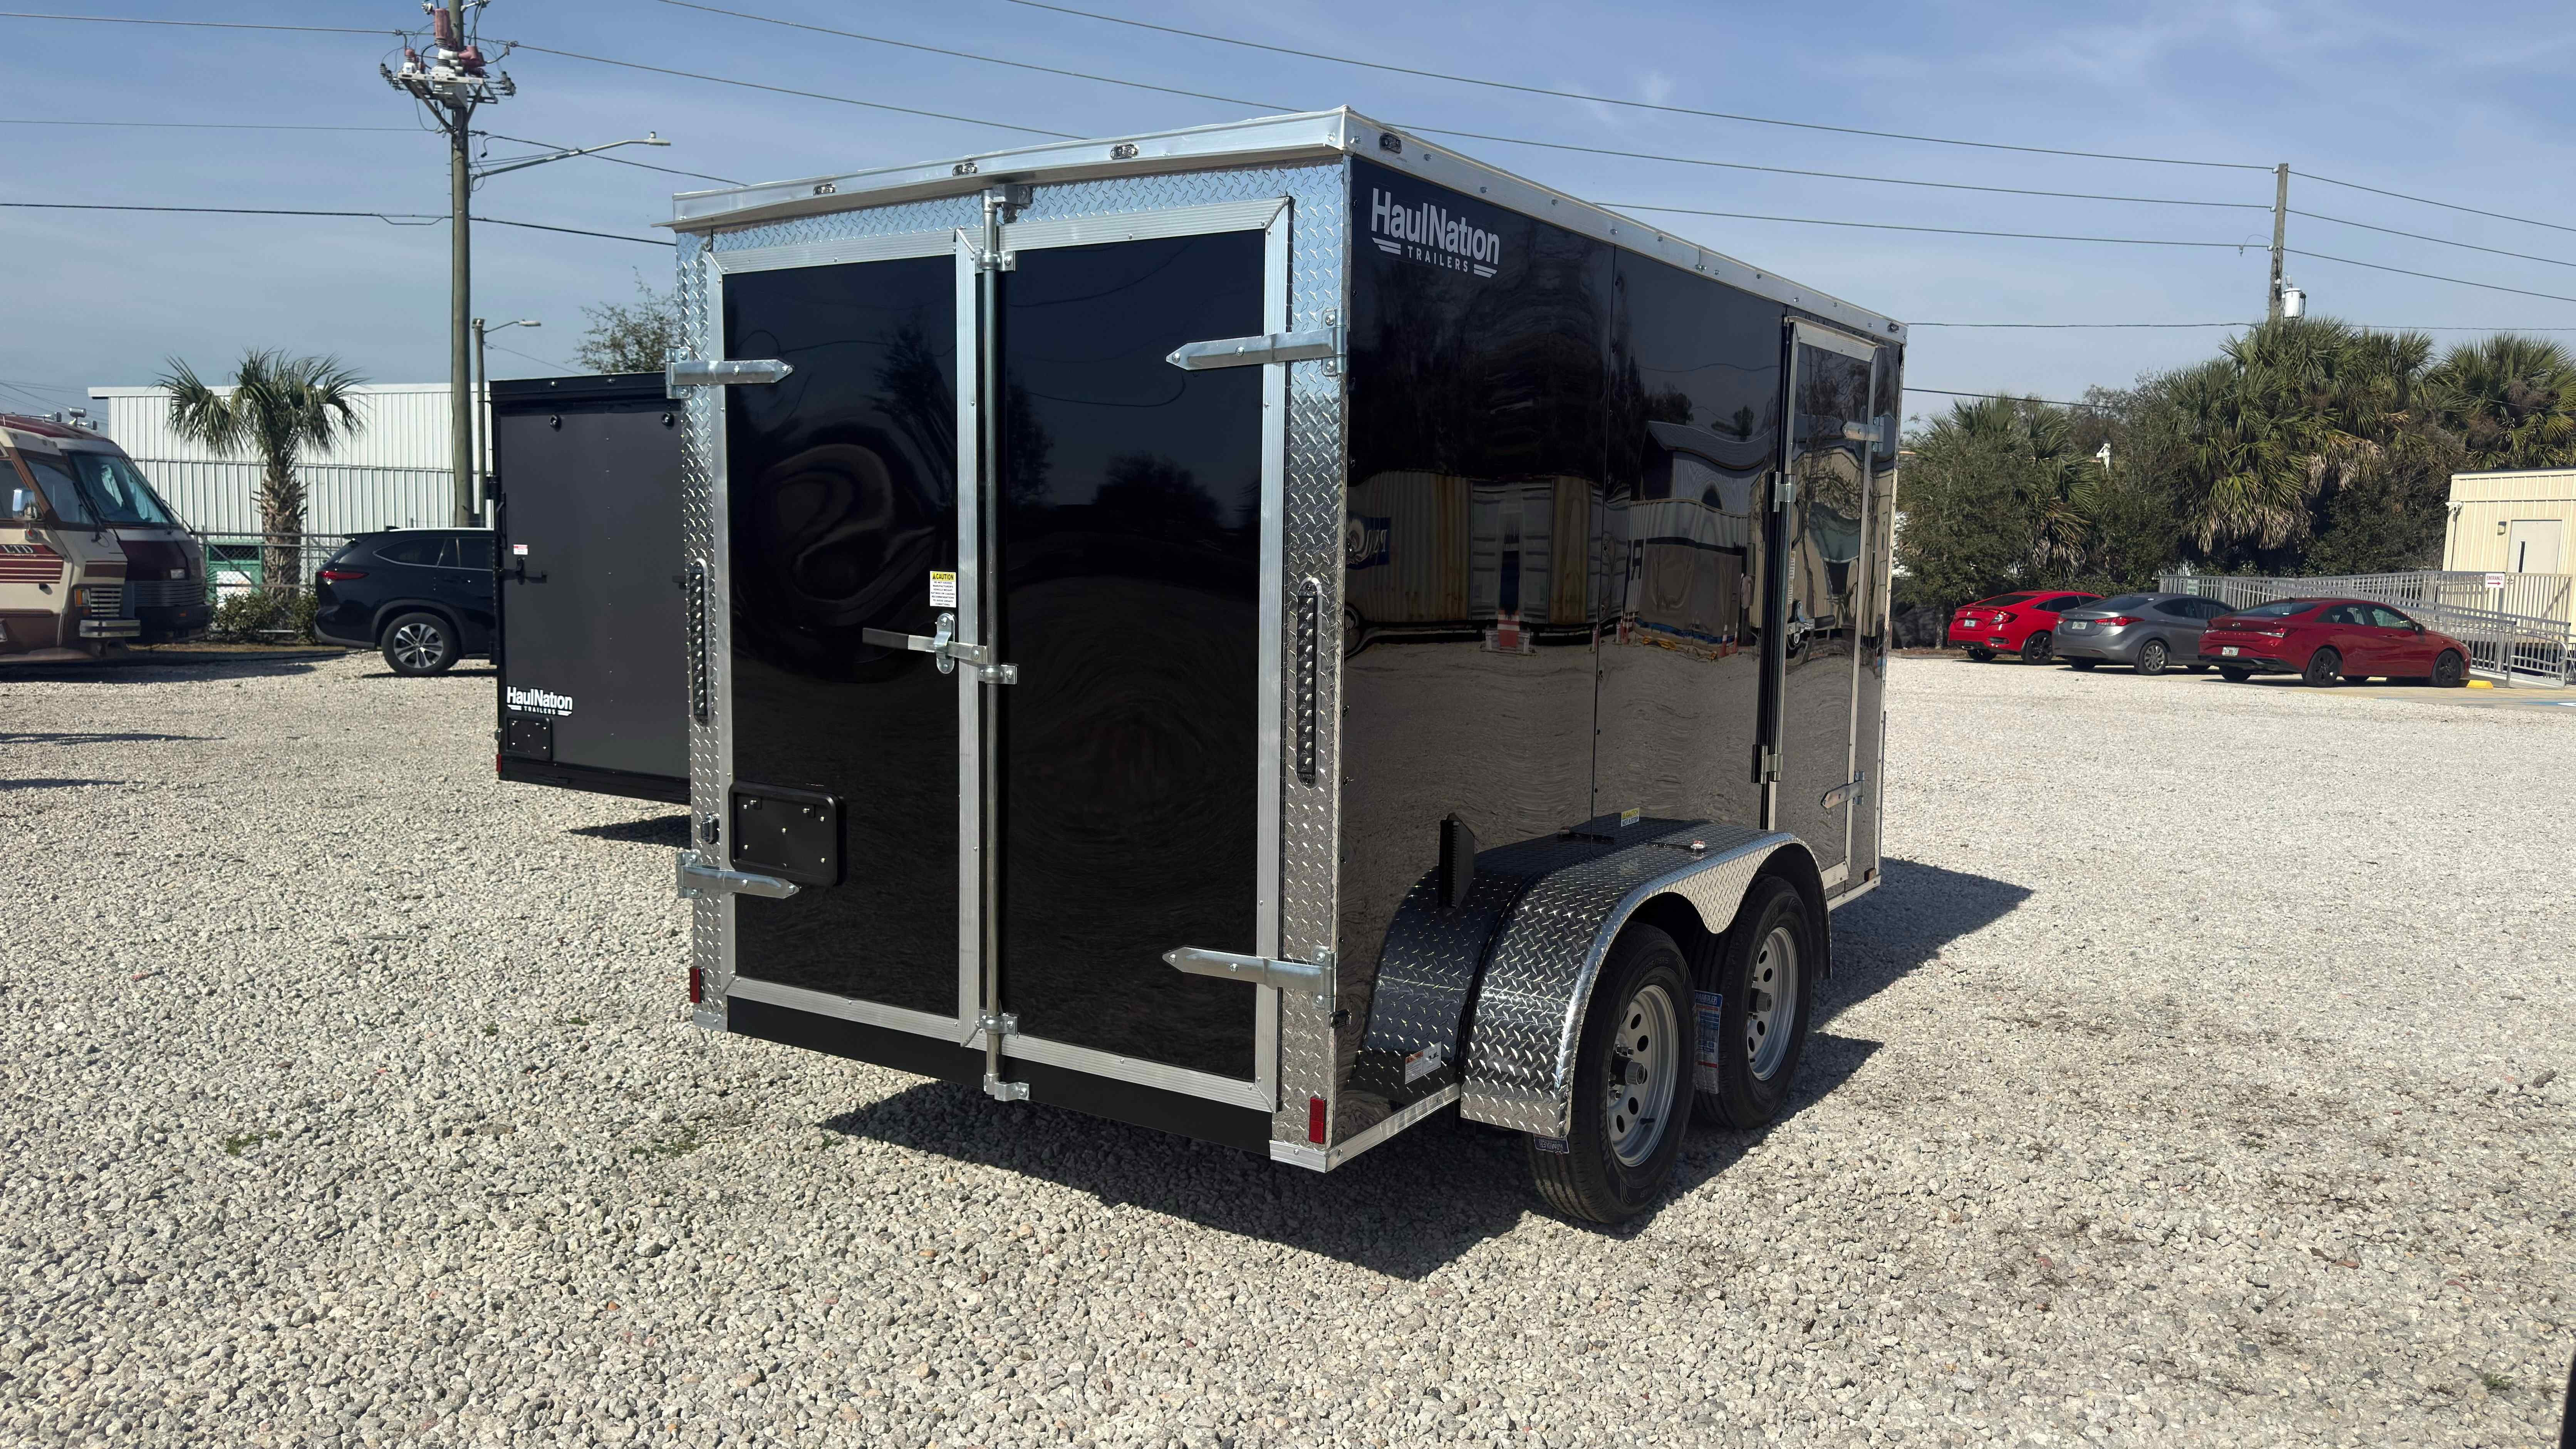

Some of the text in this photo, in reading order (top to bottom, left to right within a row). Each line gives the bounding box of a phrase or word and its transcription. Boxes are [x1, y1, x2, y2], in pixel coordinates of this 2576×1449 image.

[1371, 188, 1500, 265] HaulNation
[1407, 245, 1468, 272] TRAILERS
[1, 545, 34, 553] LTD
[507, 686, 573, 710] HaulNation
[524, 706, 555, 714] TRAILERS
